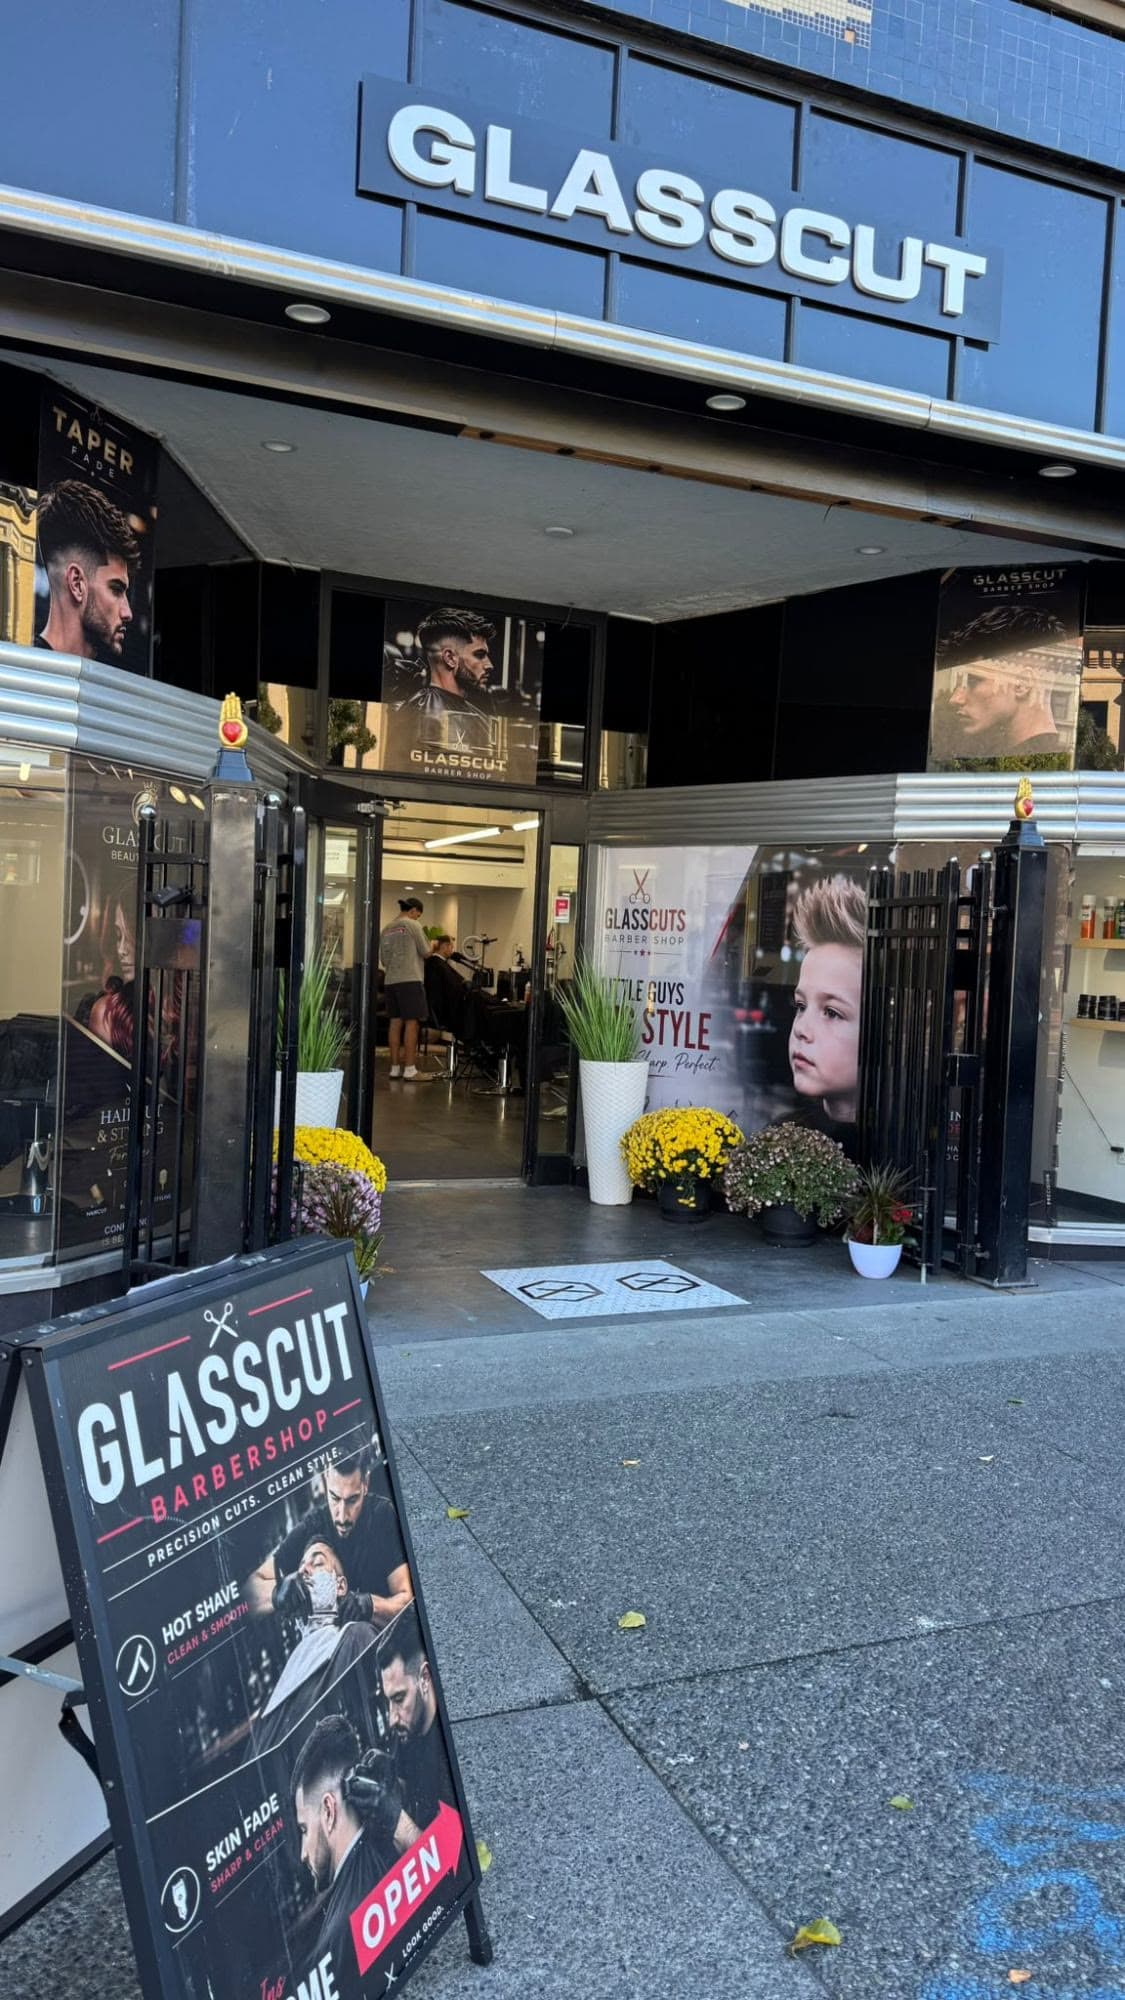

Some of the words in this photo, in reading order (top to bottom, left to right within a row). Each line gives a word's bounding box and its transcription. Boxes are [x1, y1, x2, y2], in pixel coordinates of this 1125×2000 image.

[387, 104, 988, 317] GLASSCUT
[52, 405, 136, 475] TAPER
[71, 446, 116, 479] FADE
[973, 568, 1067, 587] GLASSCUT
[983, 584, 1023, 593] BARBER
[1029, 581, 1056, 590] SHOP
[410, 750, 507, 772] GLASSCUT
[424, 766, 463, 777] BARBER
[466, 769, 492, 780] SHOP
[604, 908, 687, 932] GLASSCUTS
[604, 933, 648, 945] BARBER
[653, 936, 685, 946] SHOP
[647, 980, 685, 1006] GUYS
[641, 1005, 712, 1051] STYLE
[77, 1301, 353, 1505] GLASSCUT
[151, 1409, 328, 1524] BARBERSHOP
[147, 1514, 221, 1568] PRECISION
[224, 1496, 261, 1522] CUTS.
[267, 1466, 304, 1496] CLEAN
[307, 1446, 342, 1473] STYLE.
[161, 1610, 193, 1646] HOT
[195, 1580, 240, 1623] SHAVE
[167, 1634, 200, 1665] CLEAN
[201, 1628, 209, 1642] &
[210, 1600, 250, 1636] SMOOTH
[205, 1826, 242, 1872] SKIN
[243, 1792, 280, 1838] FADE
[210, 1855, 243, 1893] SHARP
[244, 1848, 253, 1861] &
[254, 1816, 284, 1852] CLEAN
[362, 1835, 442, 1950] OPEN
[402, 1928, 422, 1958] LOOK
[422, 1904, 446, 1932] GOOD.
